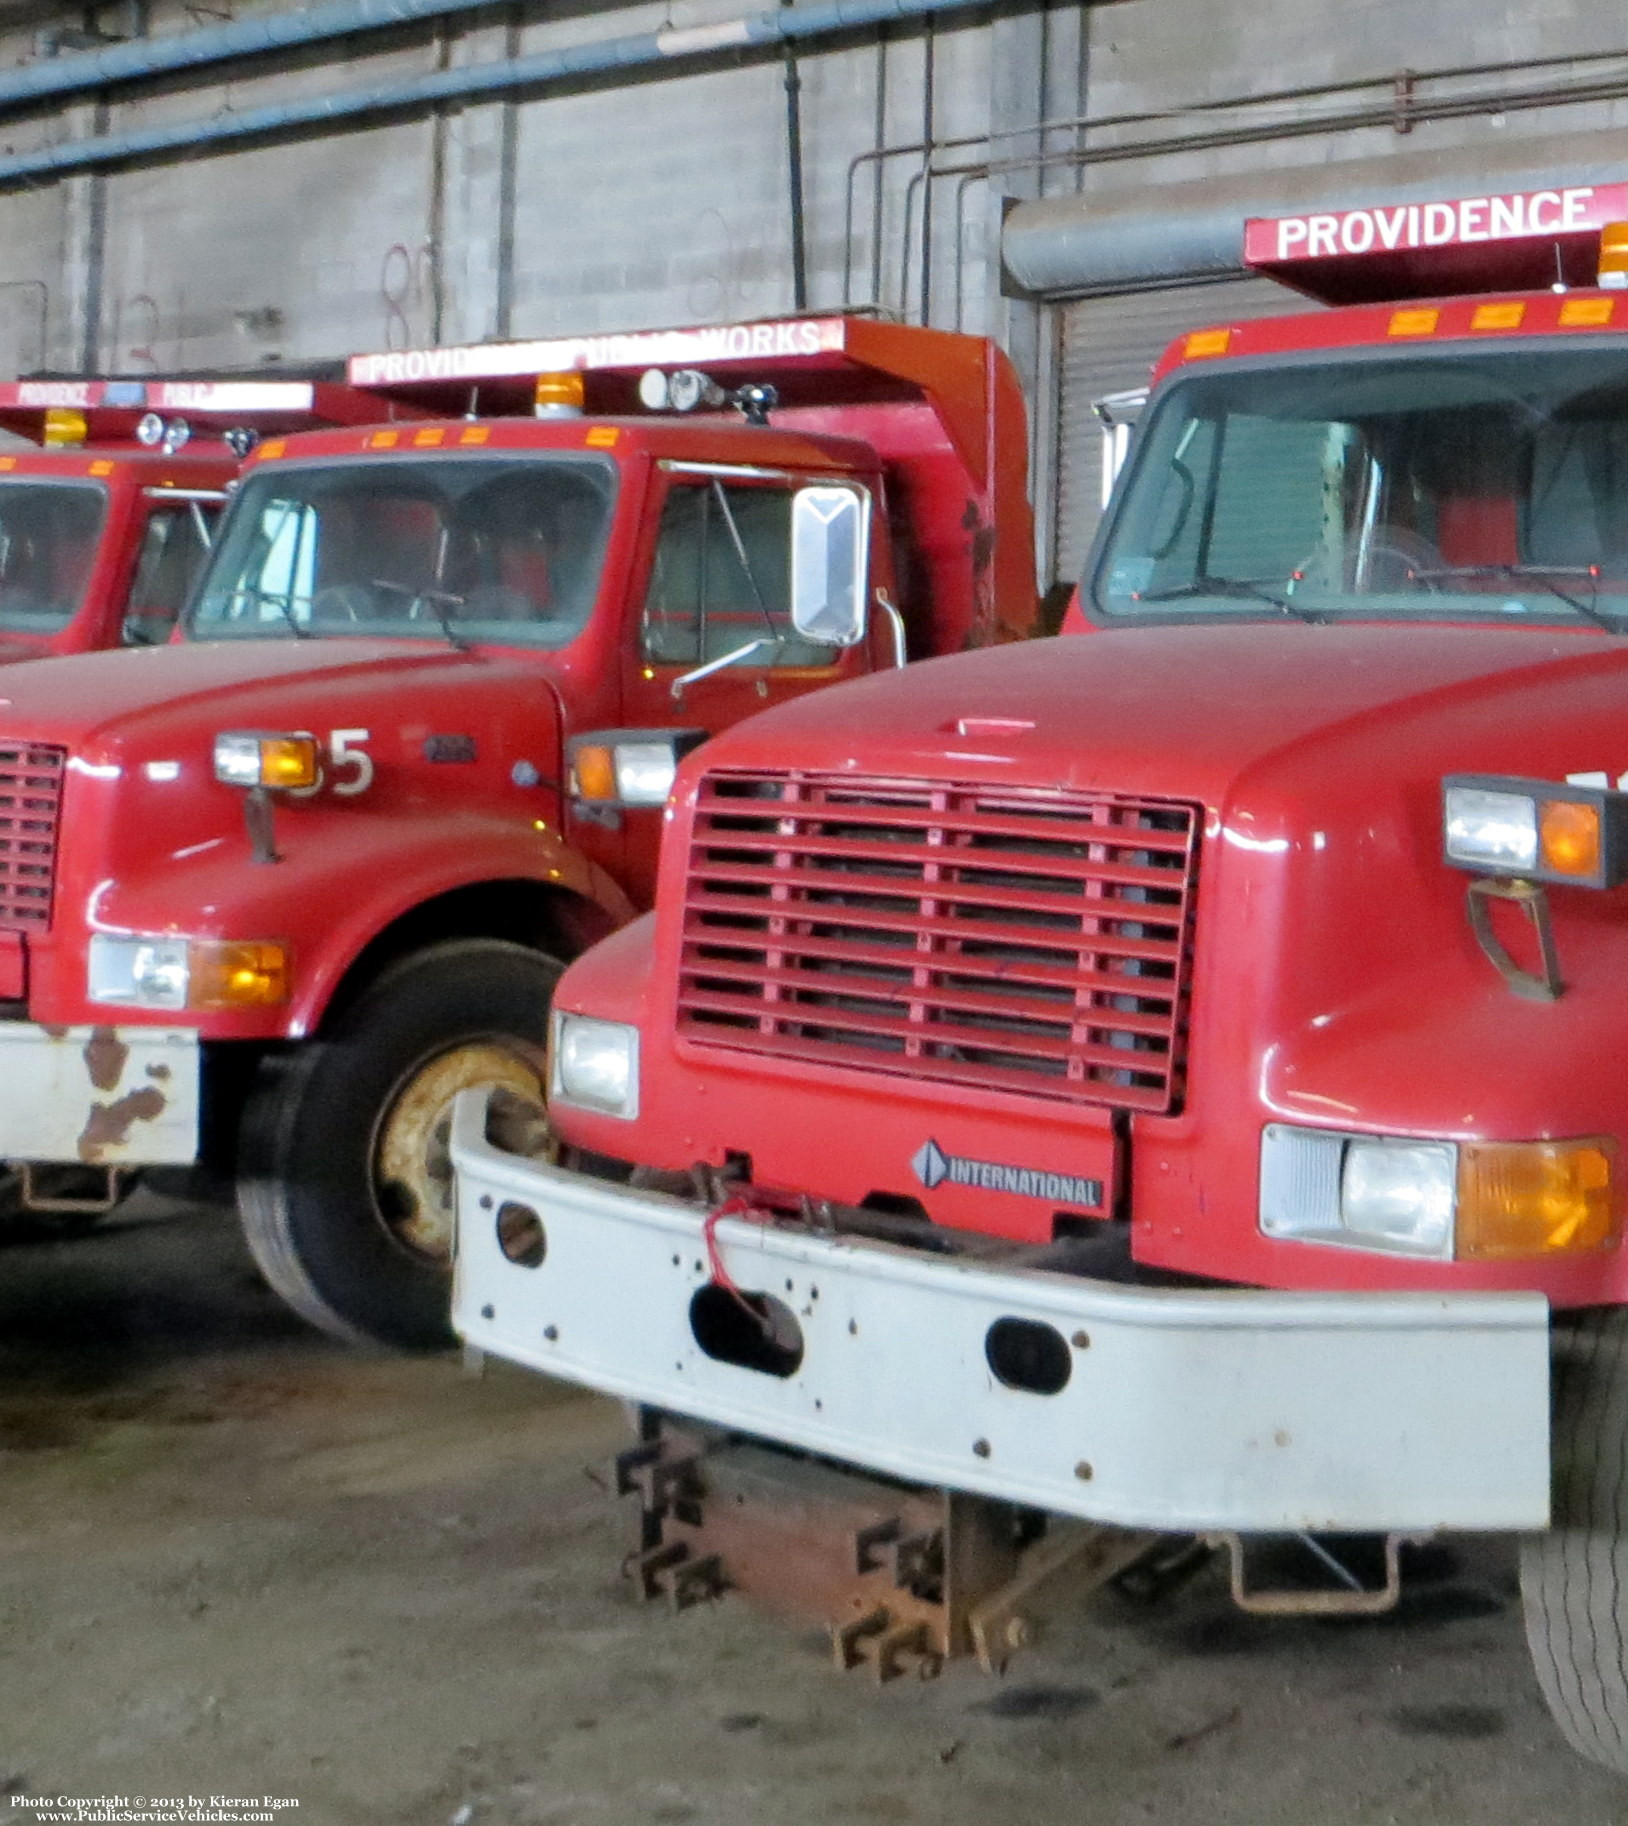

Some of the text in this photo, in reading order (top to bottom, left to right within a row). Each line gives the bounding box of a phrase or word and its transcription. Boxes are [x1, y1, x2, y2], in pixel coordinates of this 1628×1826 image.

[1276, 188, 1595, 260] PROVIDENCE
[700, 321, 823, 358] WORKS
[949, 1157, 1098, 1207] INTERNATIONAL
